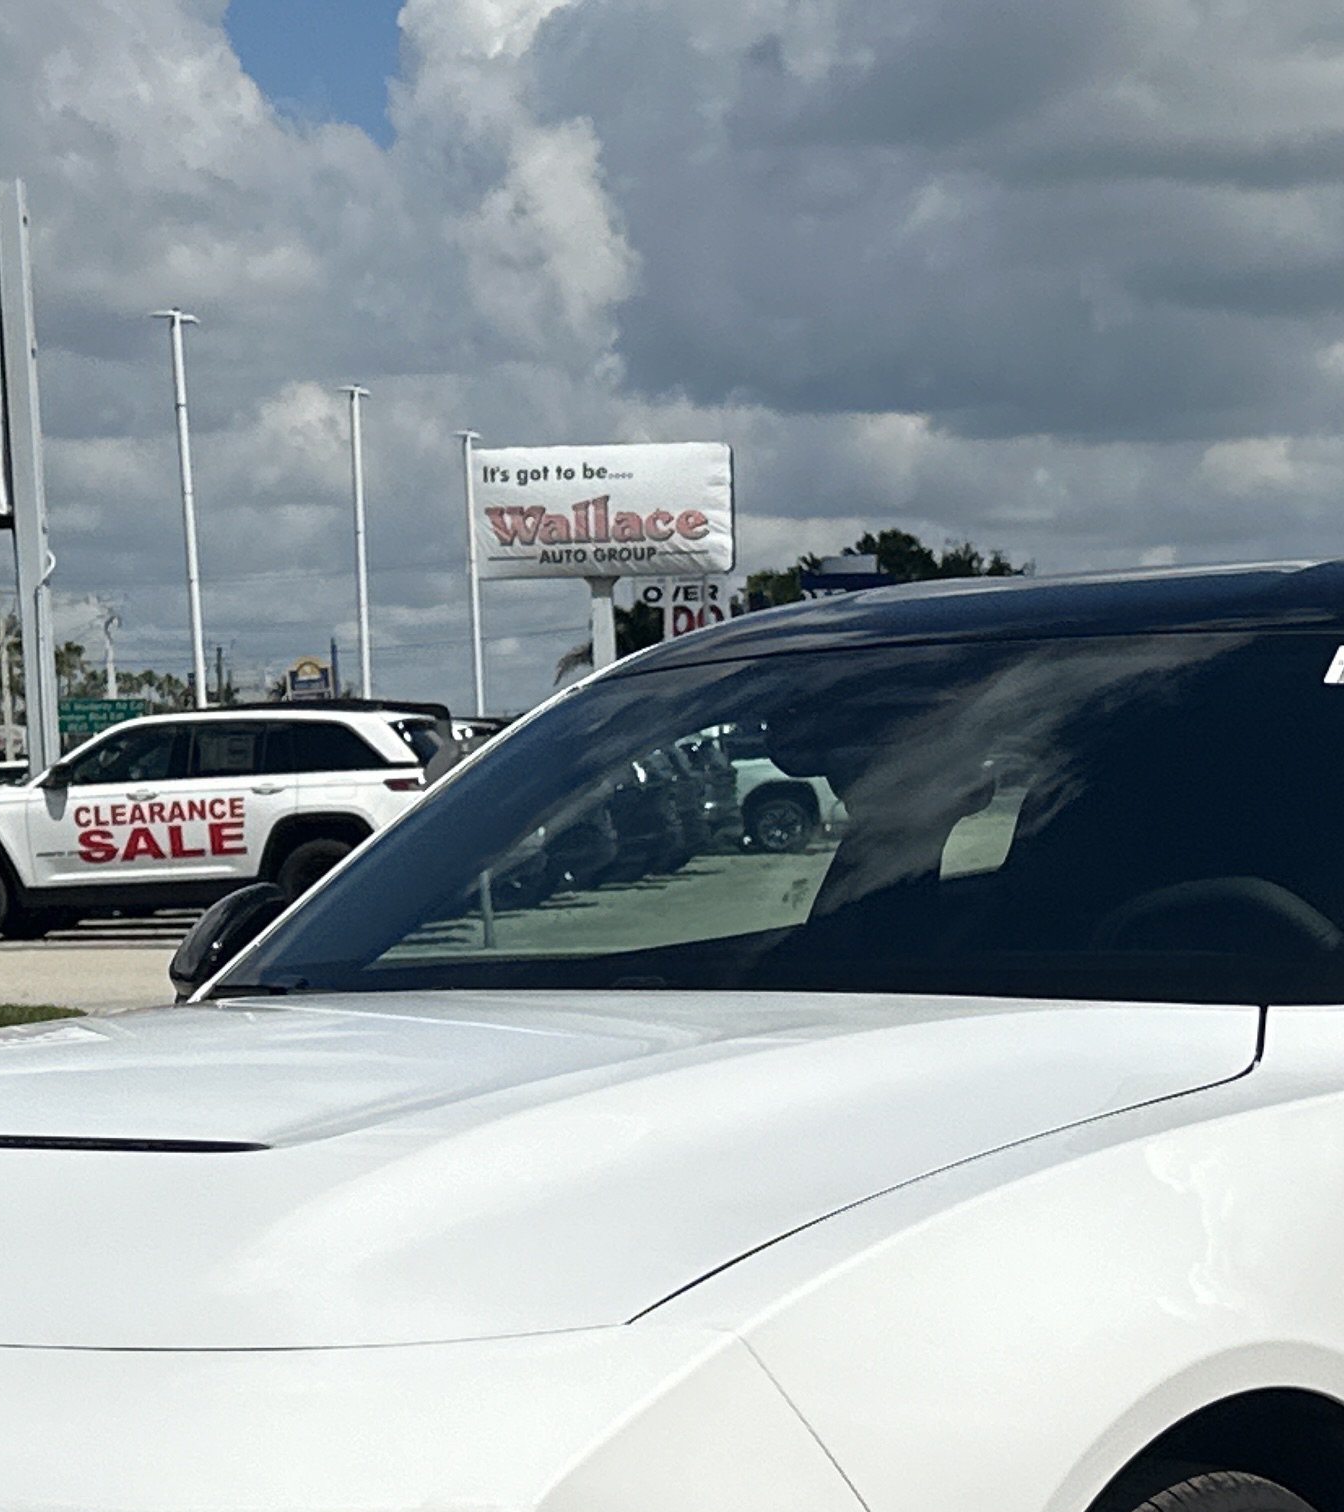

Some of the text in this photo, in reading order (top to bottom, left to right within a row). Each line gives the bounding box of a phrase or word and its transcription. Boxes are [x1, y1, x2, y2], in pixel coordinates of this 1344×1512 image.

[483, 465, 510, 483] It's
[517, 466, 549, 485] got
[556, 465, 575, 480] to
[485, 494, 710, 547] Wallace
[539, 547, 657, 564] AUTO GROUP
[74, 797, 246, 828] CLEARANCE
[77, 821, 248, 864] SALE
